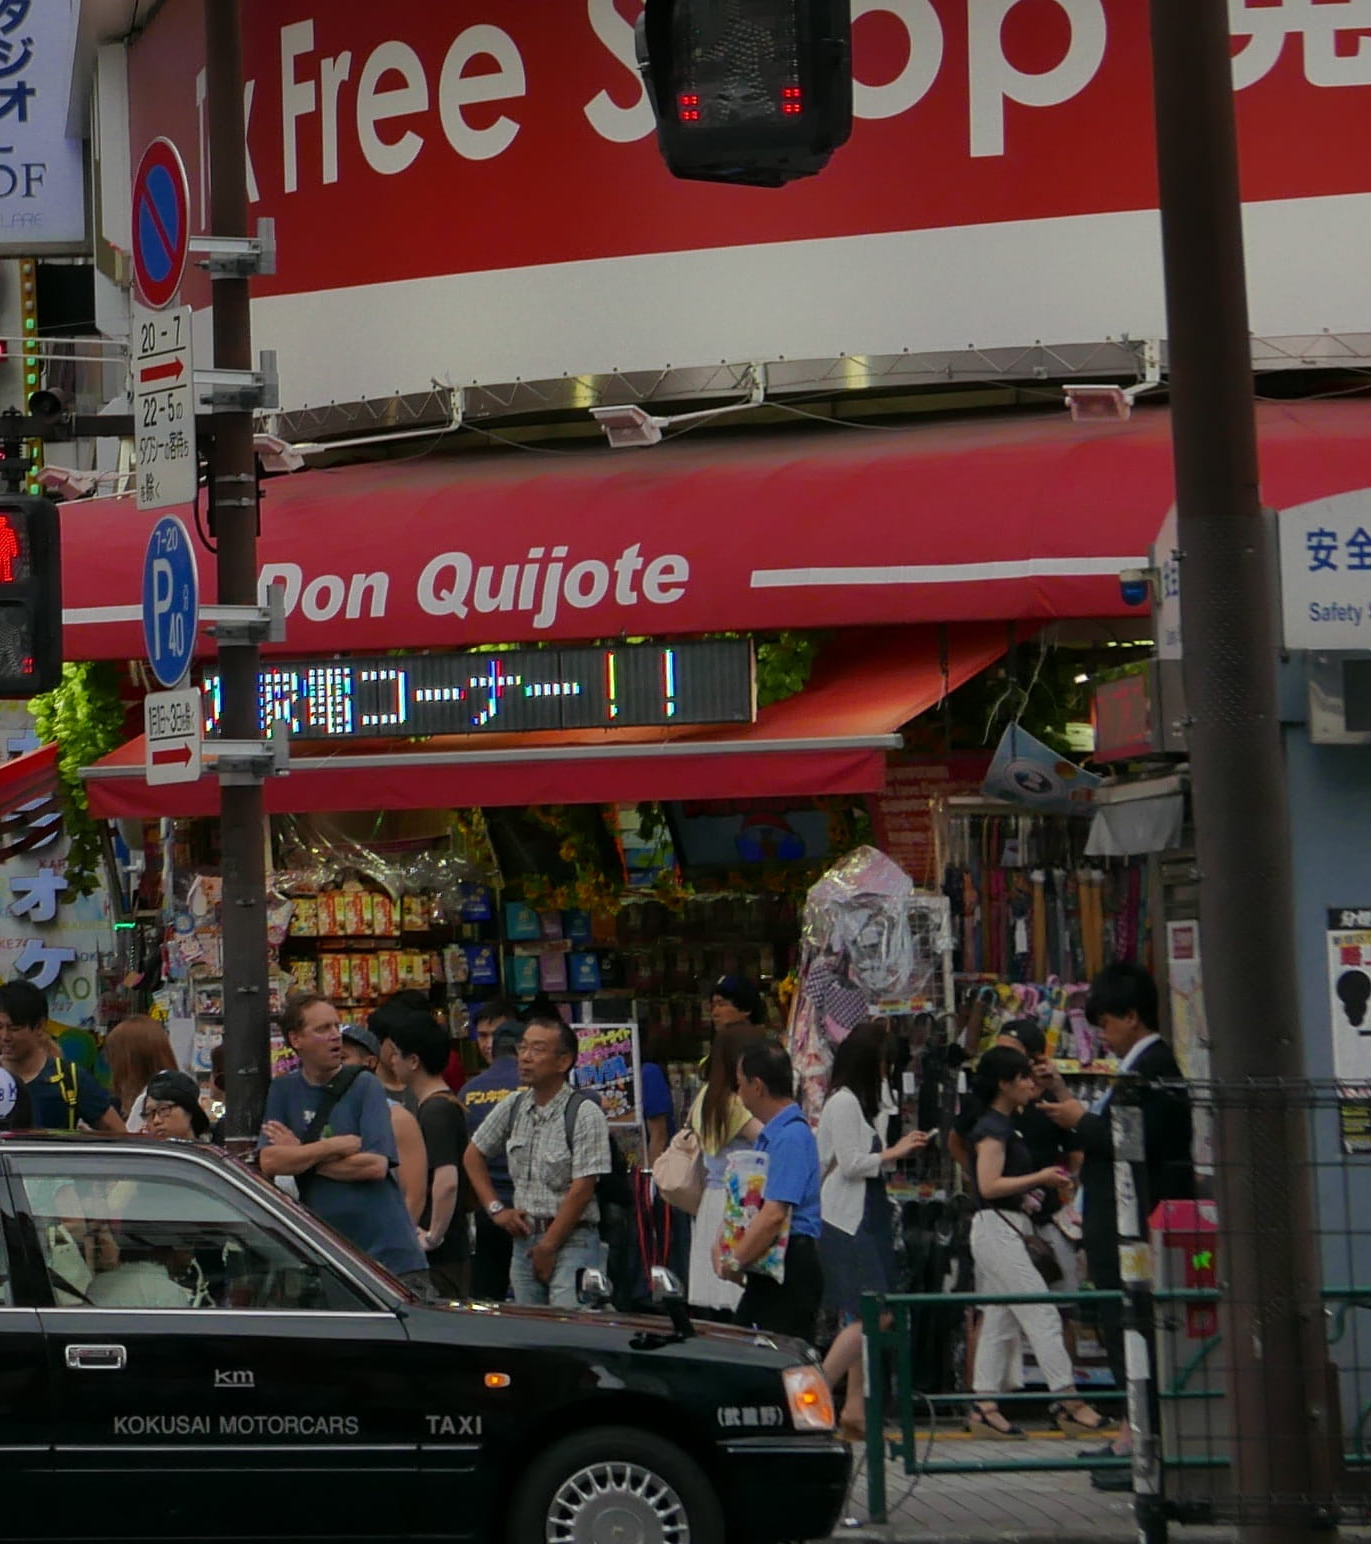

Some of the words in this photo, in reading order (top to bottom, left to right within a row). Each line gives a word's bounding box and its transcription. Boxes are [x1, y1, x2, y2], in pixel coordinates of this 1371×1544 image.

[280, 18, 528, 194] Free
[258, 561, 389, 624] Don
[416, 542, 690, 630] Quijote
[152, 558, 174, 662] P
[1309, 602, 1363, 627] Safety
[168, 611, 185, 657] 40
[214, 1368, 255, 1387] km
[113, 1416, 211, 1435] KOKUSAI
[219, 1415, 359, 1436] MOTORCARS
[426, 1415, 483, 1436] TAXI
